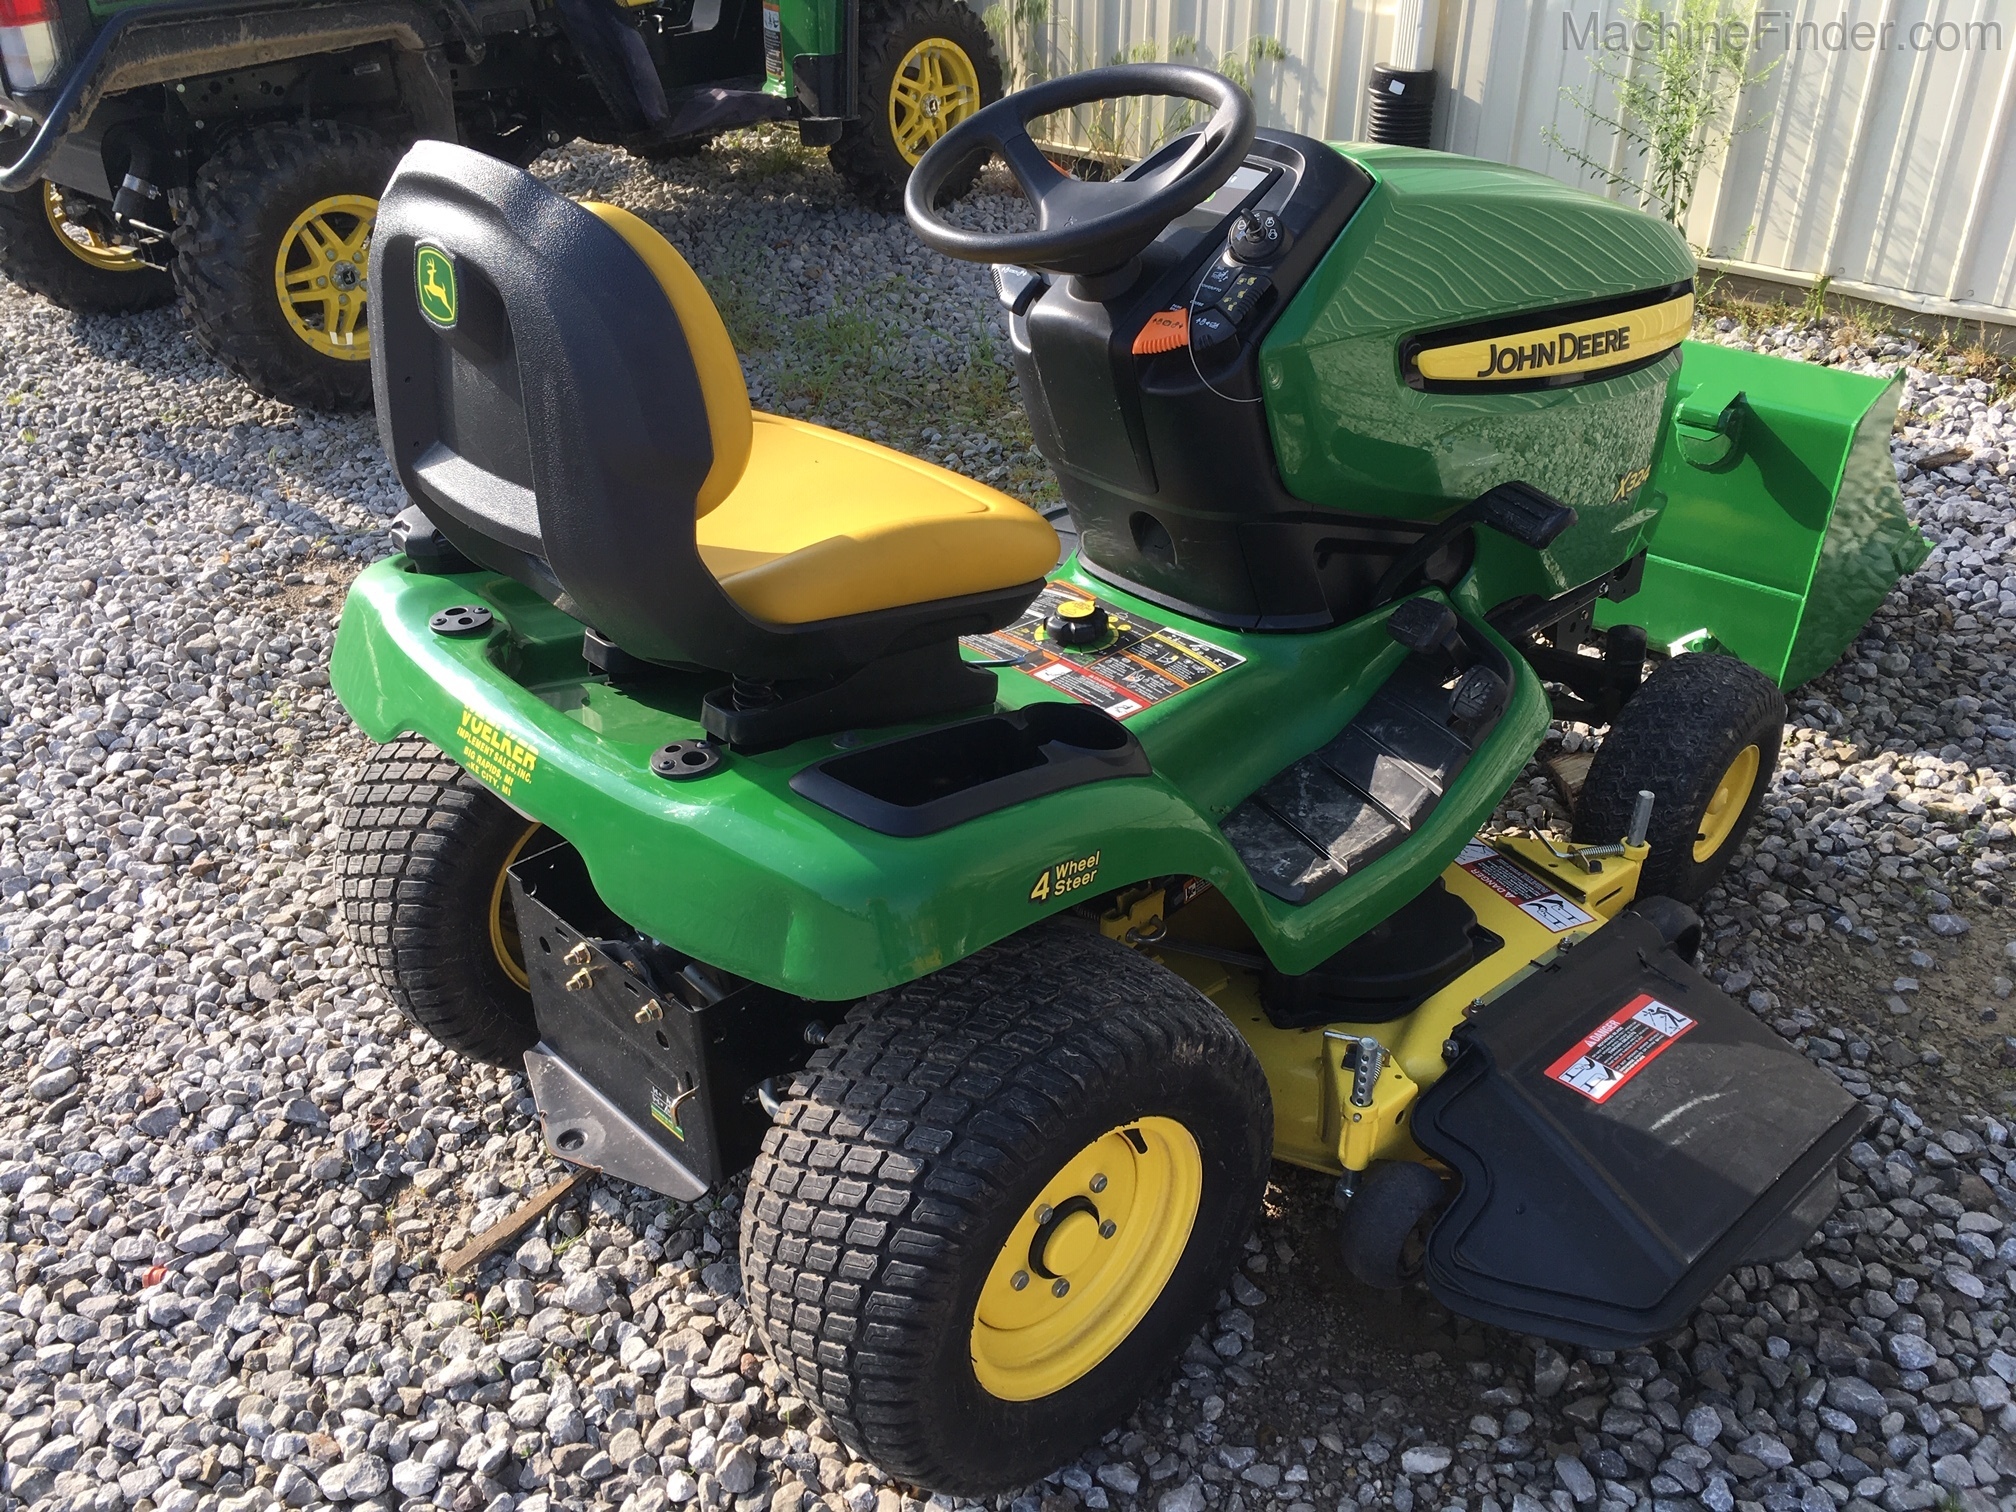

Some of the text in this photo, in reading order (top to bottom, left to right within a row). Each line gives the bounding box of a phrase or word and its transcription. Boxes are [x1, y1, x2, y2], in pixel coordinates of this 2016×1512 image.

[1477, 326, 1631, 377] JOHN DEERE
[457, 726, 495, 757] IMPLEMENT
[463, 745, 514, 787] BIG RAPIDS, MI
[481, 770, 500, 789] CITY,
[501, 784, 511, 797] MI
[1055, 850, 1100, 880] Wheel
[1030, 871, 1051, 900] 4
[1054, 868, 1097, 896] Steer
[1470, 868, 1506, 893] DANGER
[1588, 1019, 1621, 1041] DANGER
